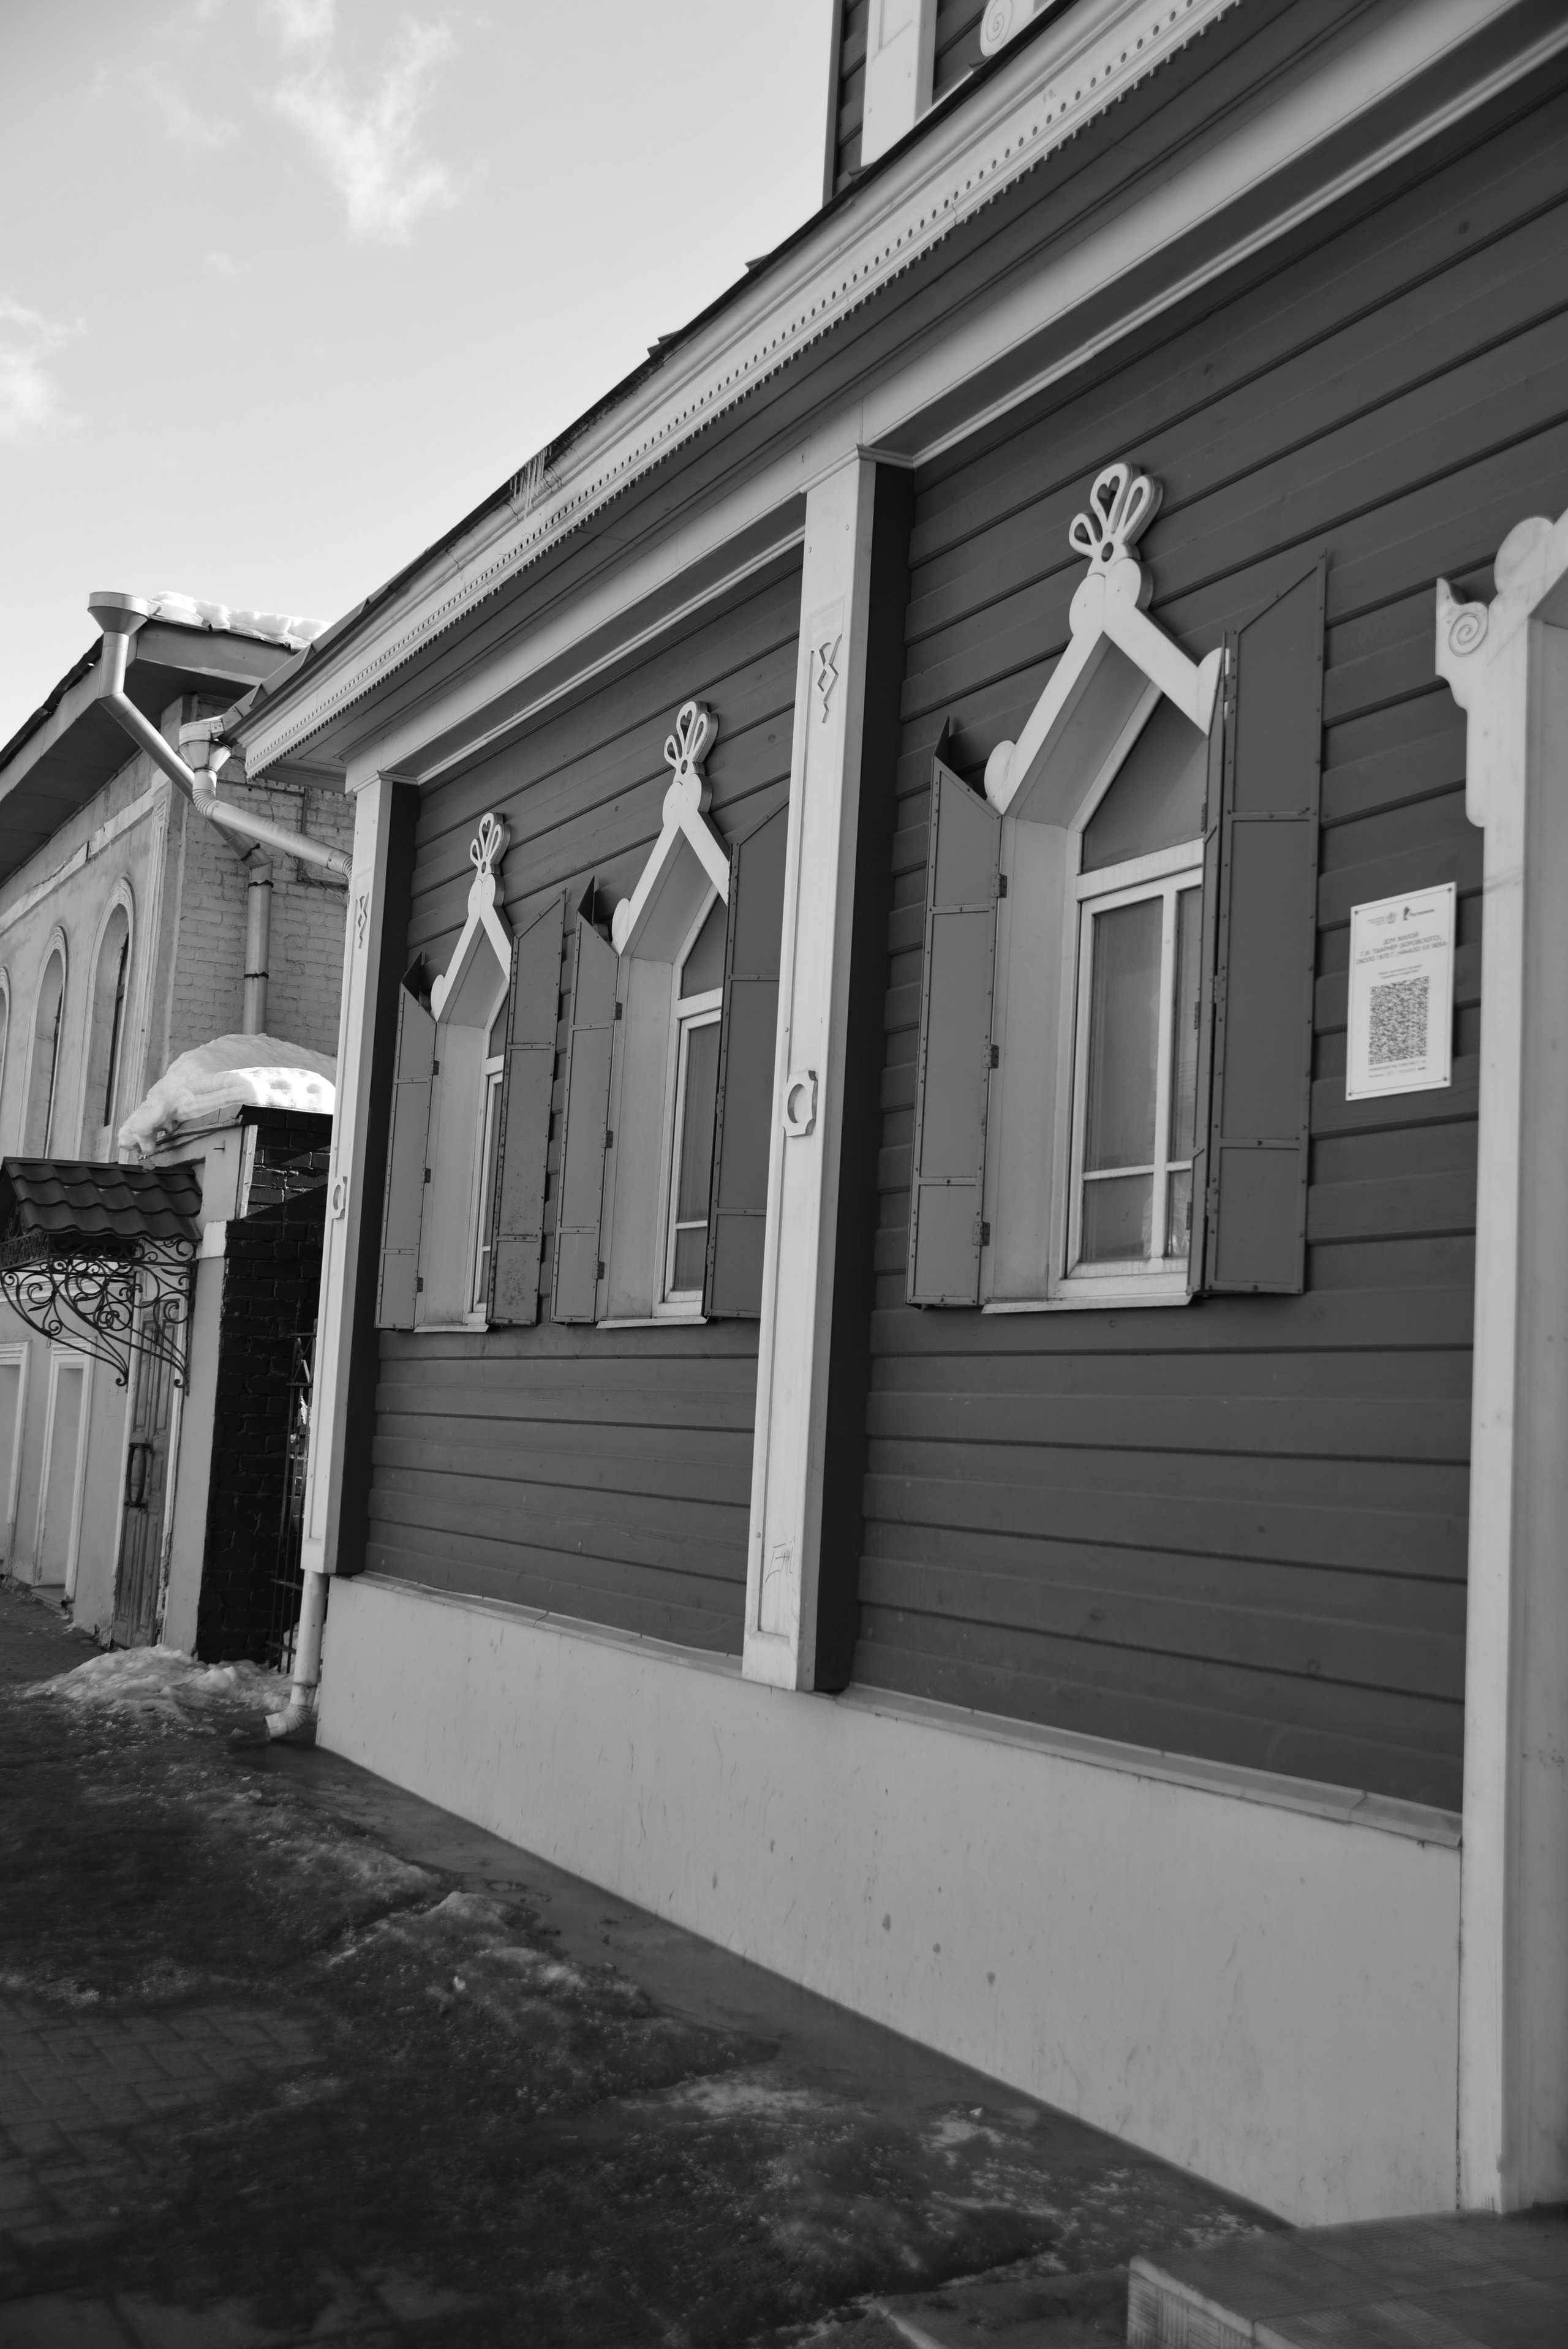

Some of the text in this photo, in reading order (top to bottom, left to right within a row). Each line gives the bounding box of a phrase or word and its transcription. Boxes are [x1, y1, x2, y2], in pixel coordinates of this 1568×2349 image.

[1396, 930, 1419, 941] ЖИЛОЙ
[1355, 956, 1375, 965] ОКОЛО
[1431, 940, 1447, 949] ВЕКА
